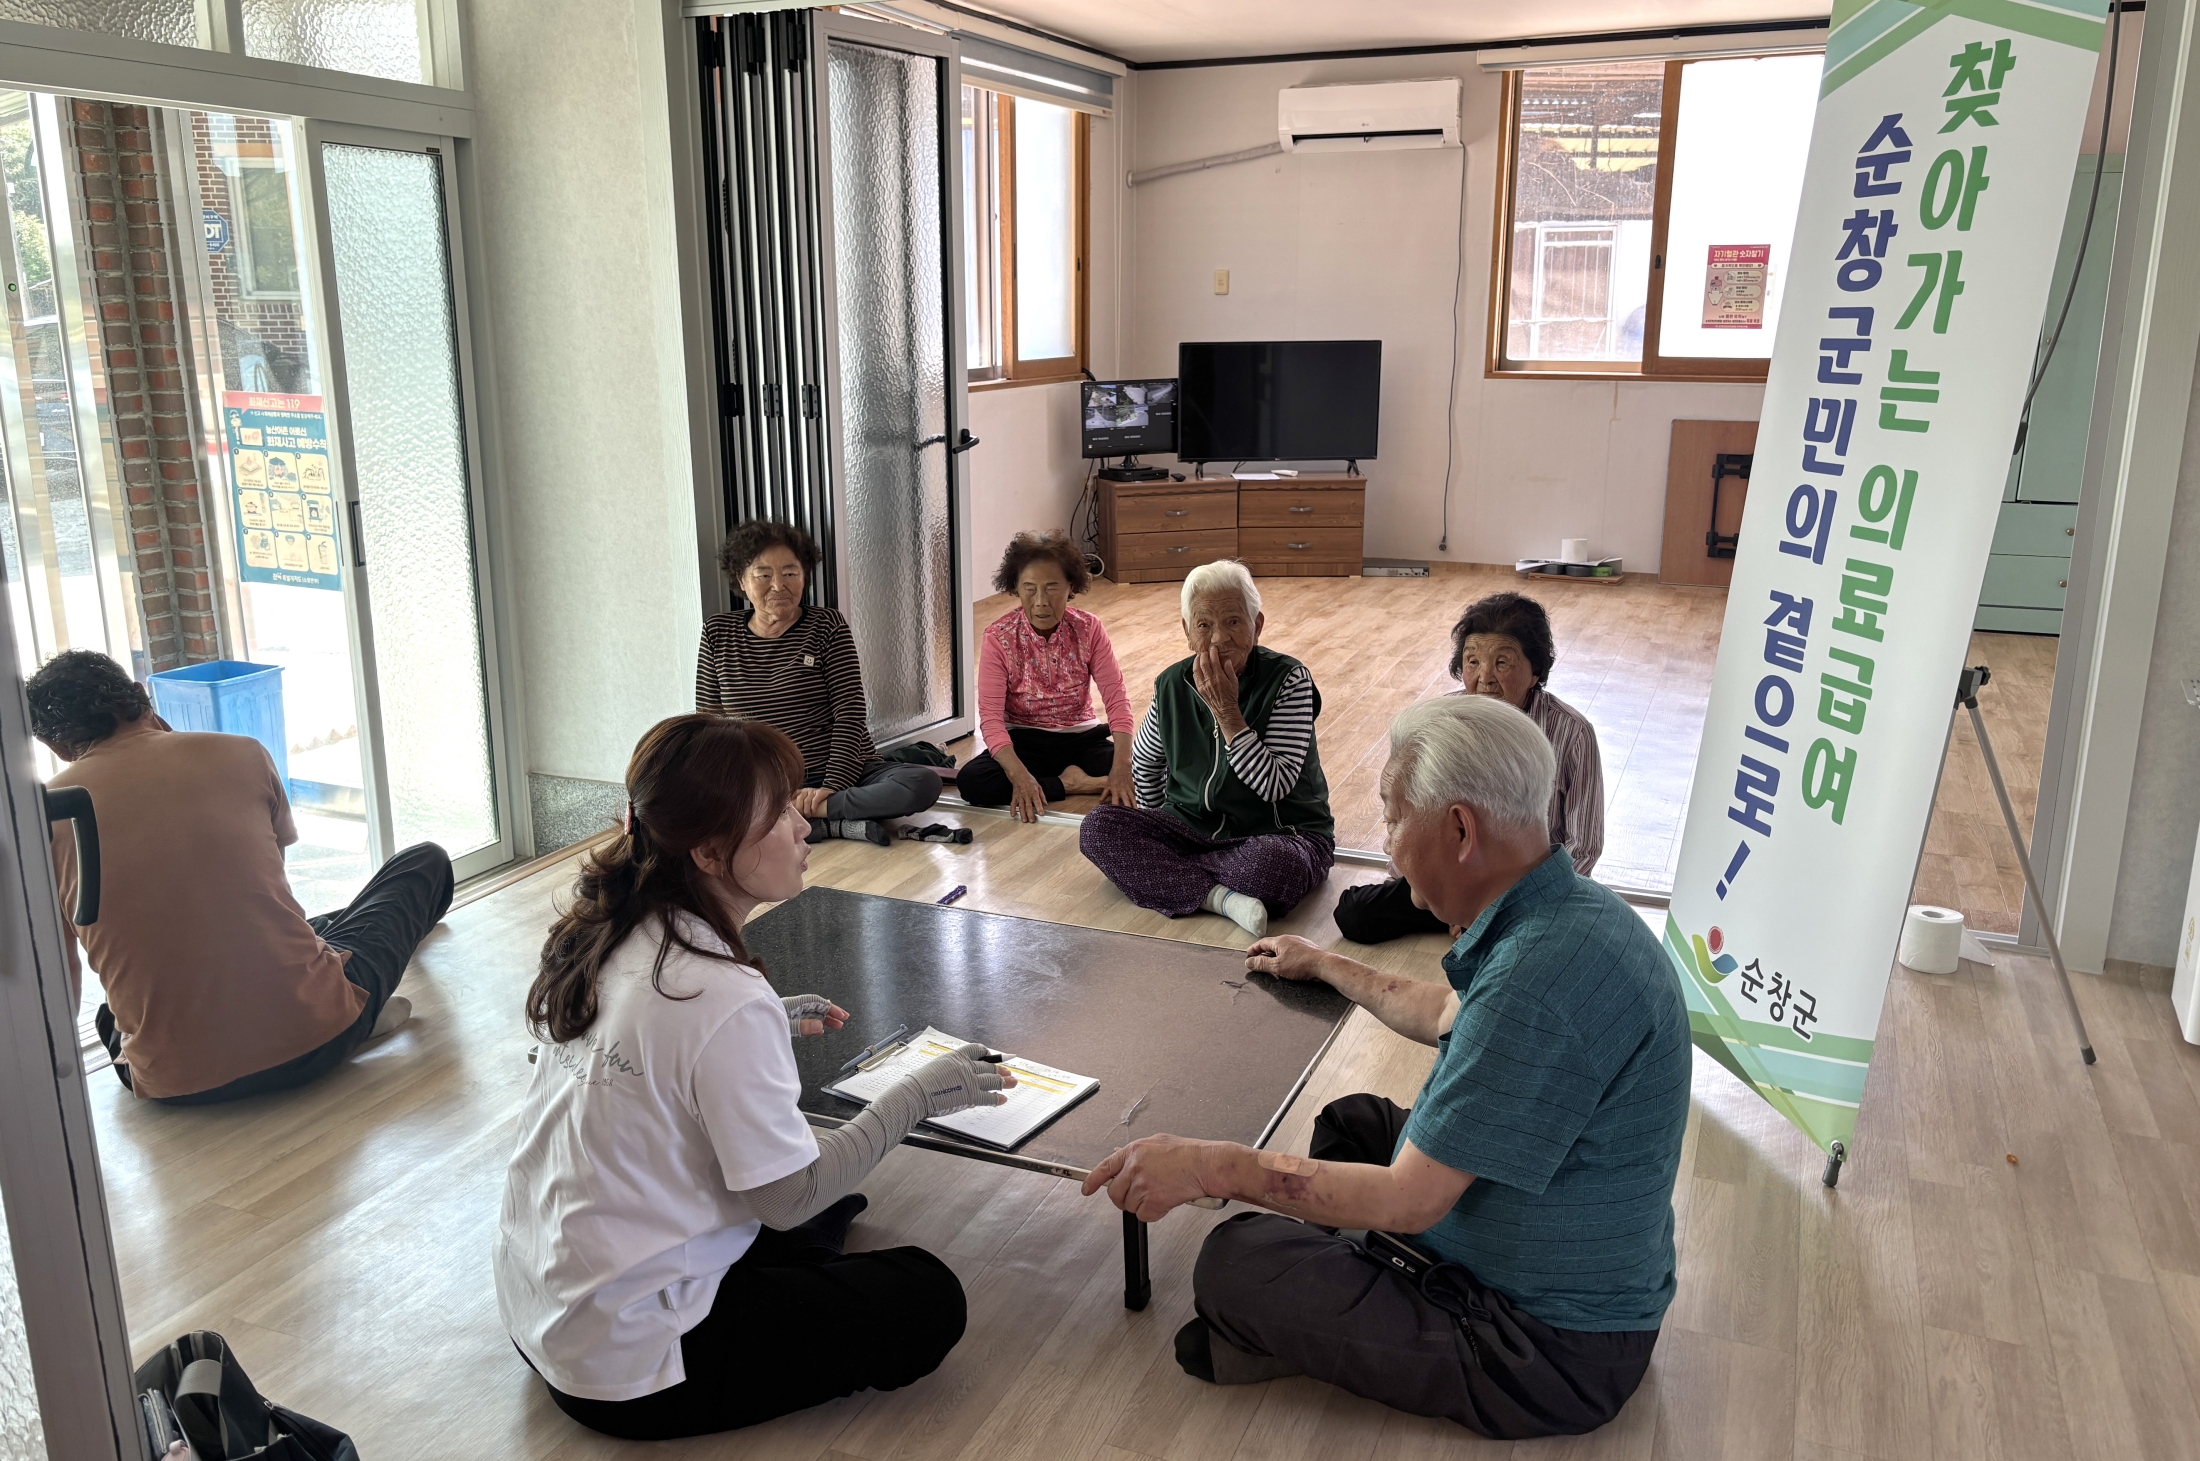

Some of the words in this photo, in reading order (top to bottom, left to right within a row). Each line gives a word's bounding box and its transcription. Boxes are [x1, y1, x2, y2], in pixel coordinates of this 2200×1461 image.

[203, 223, 222, 239] DT
[1739, 250, 1764, 258] 숫자알기
[1881, 38, 2016, 432] 찾아가는
[1779, 114, 1911, 565] 순창군민의
[249, 396, 285, 408] 화재신고는
[286, 398, 301, 409] 119
[265, 425, 288, 435] 농산어촌
[289, 426, 307, 437] 어르신
[266, 435, 296, 448] 화재사고
[297, 438, 327, 451] 예방수칙
[1803, 465, 1919, 824] 의료급여
[1715, 590, 1813, 900] 곁으로!
[1740, 957, 1818, 1040] 순창군
